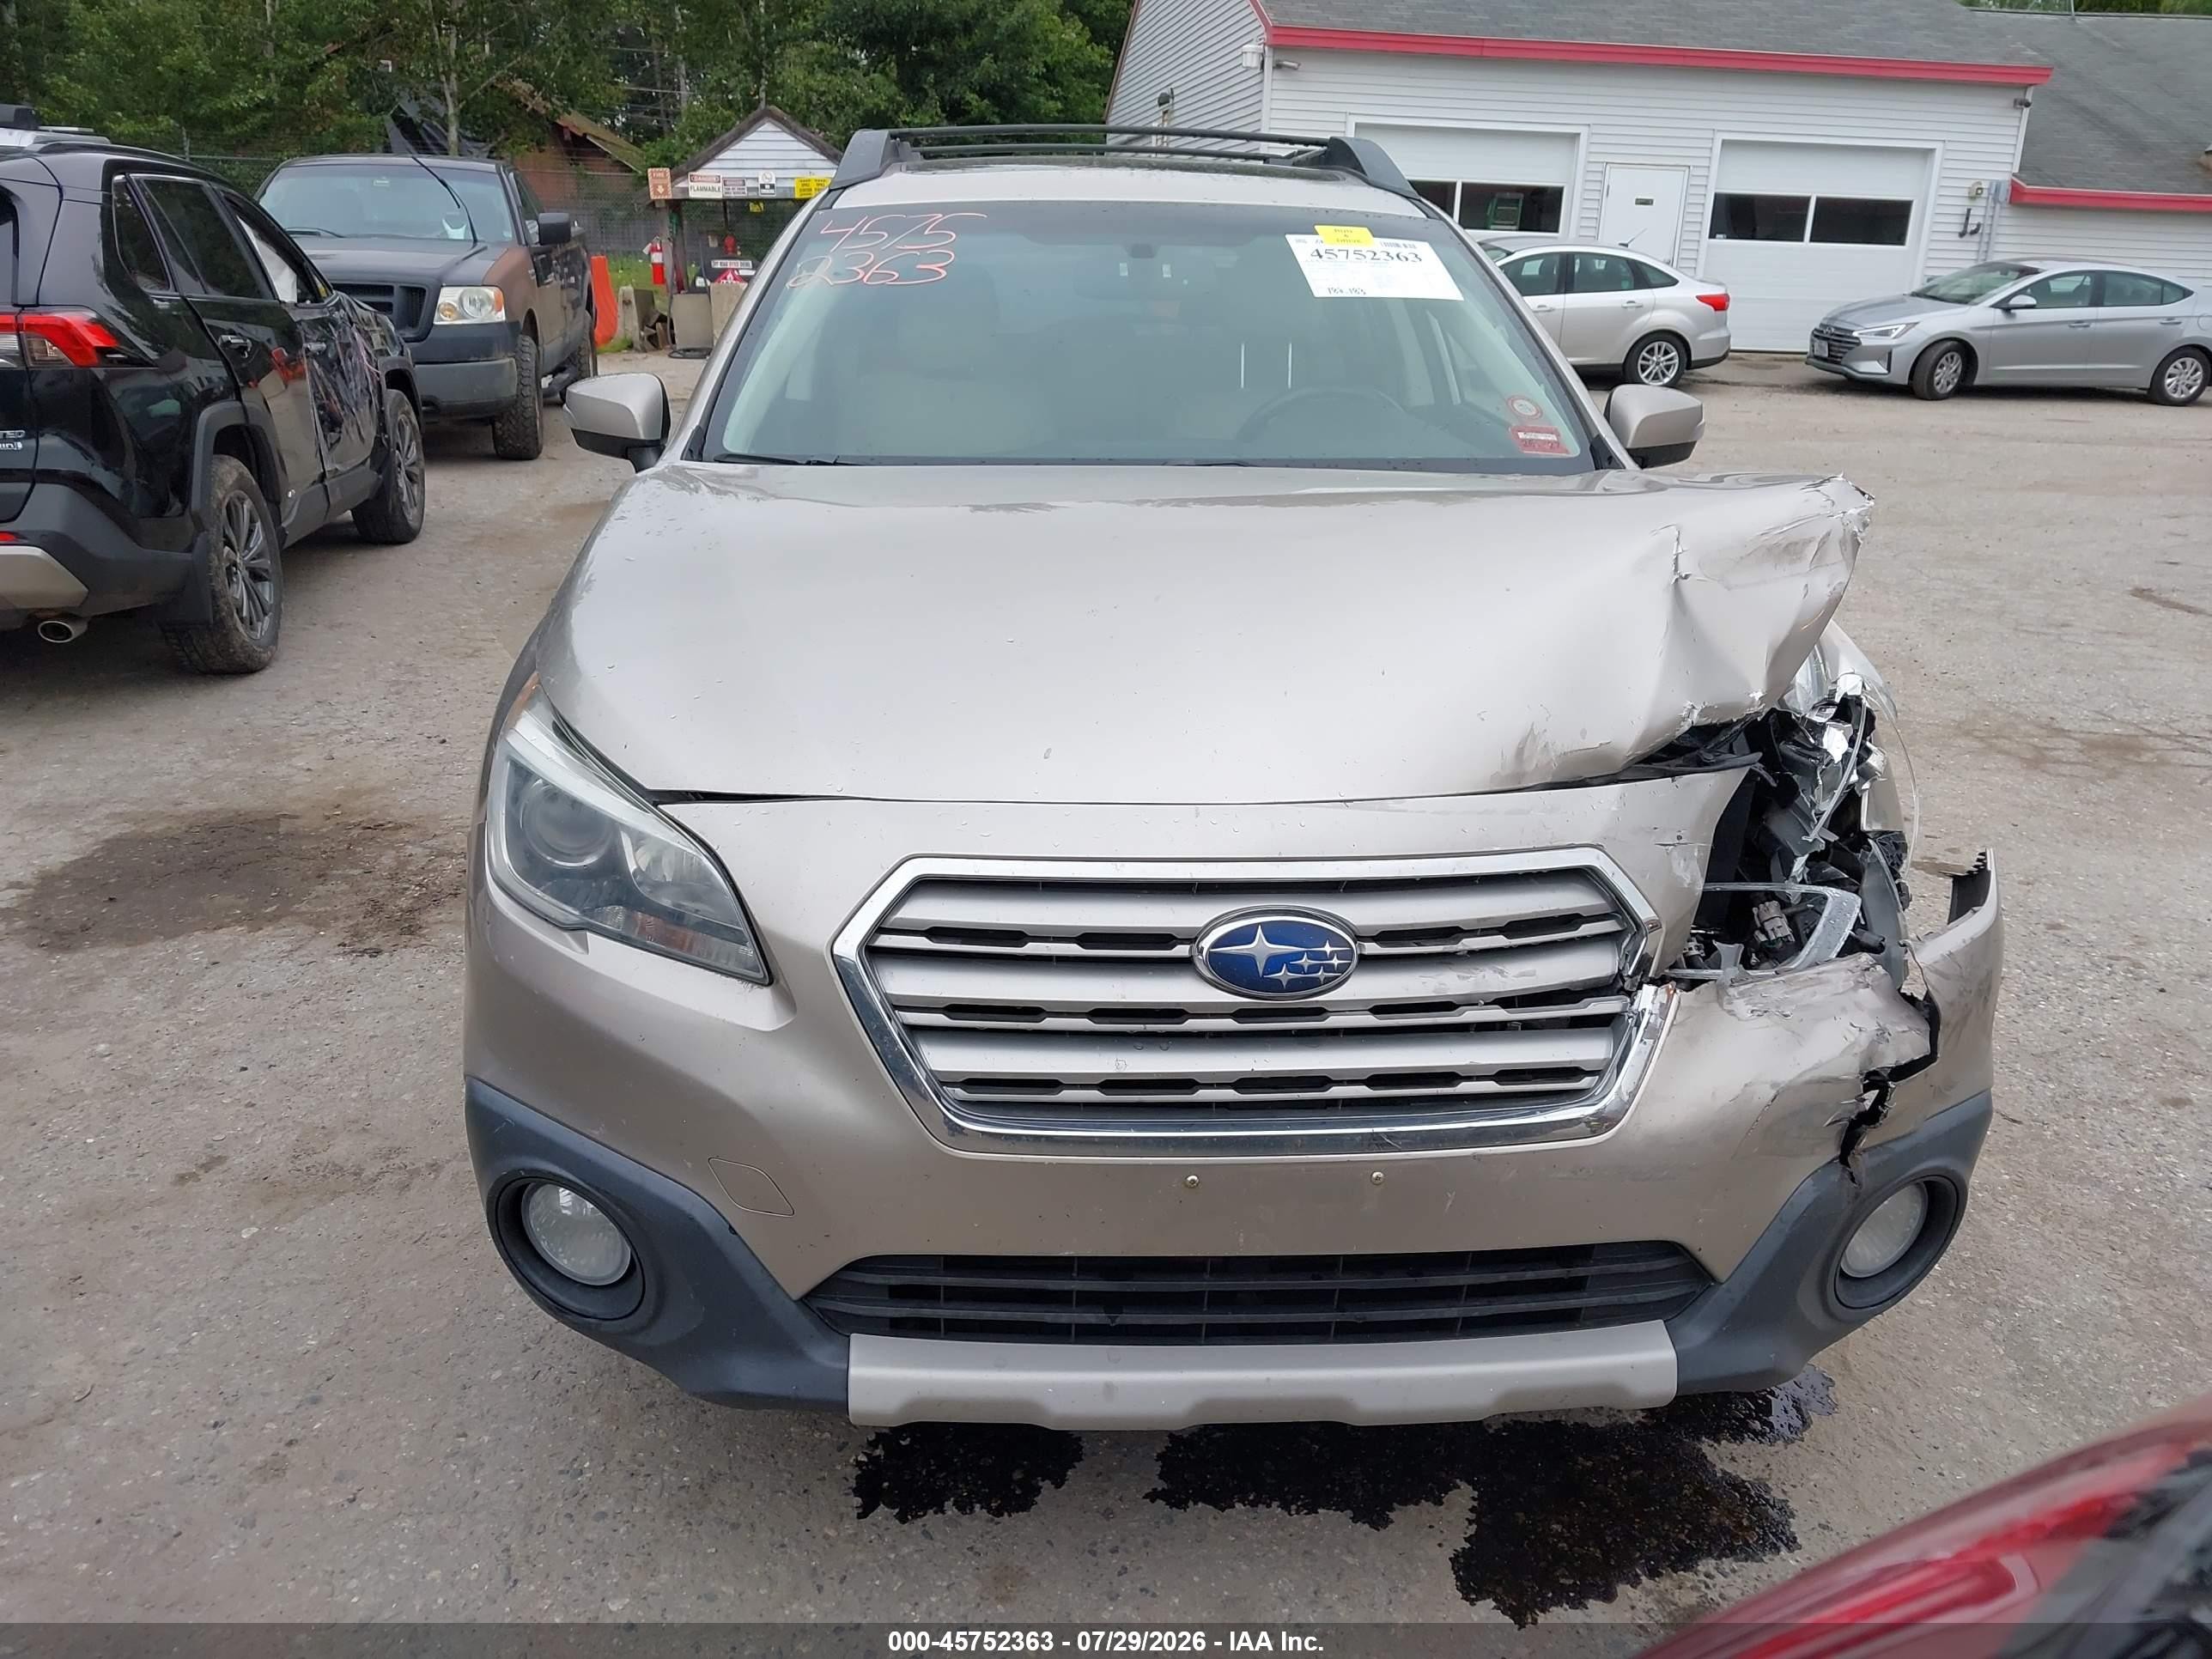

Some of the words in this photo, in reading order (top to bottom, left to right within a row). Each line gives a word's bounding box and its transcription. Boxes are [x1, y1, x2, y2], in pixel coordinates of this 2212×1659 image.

[820, 213, 988, 252] 4575
[785, 249, 955, 289] 2363
[1310, 248, 1423, 263] 45752363
